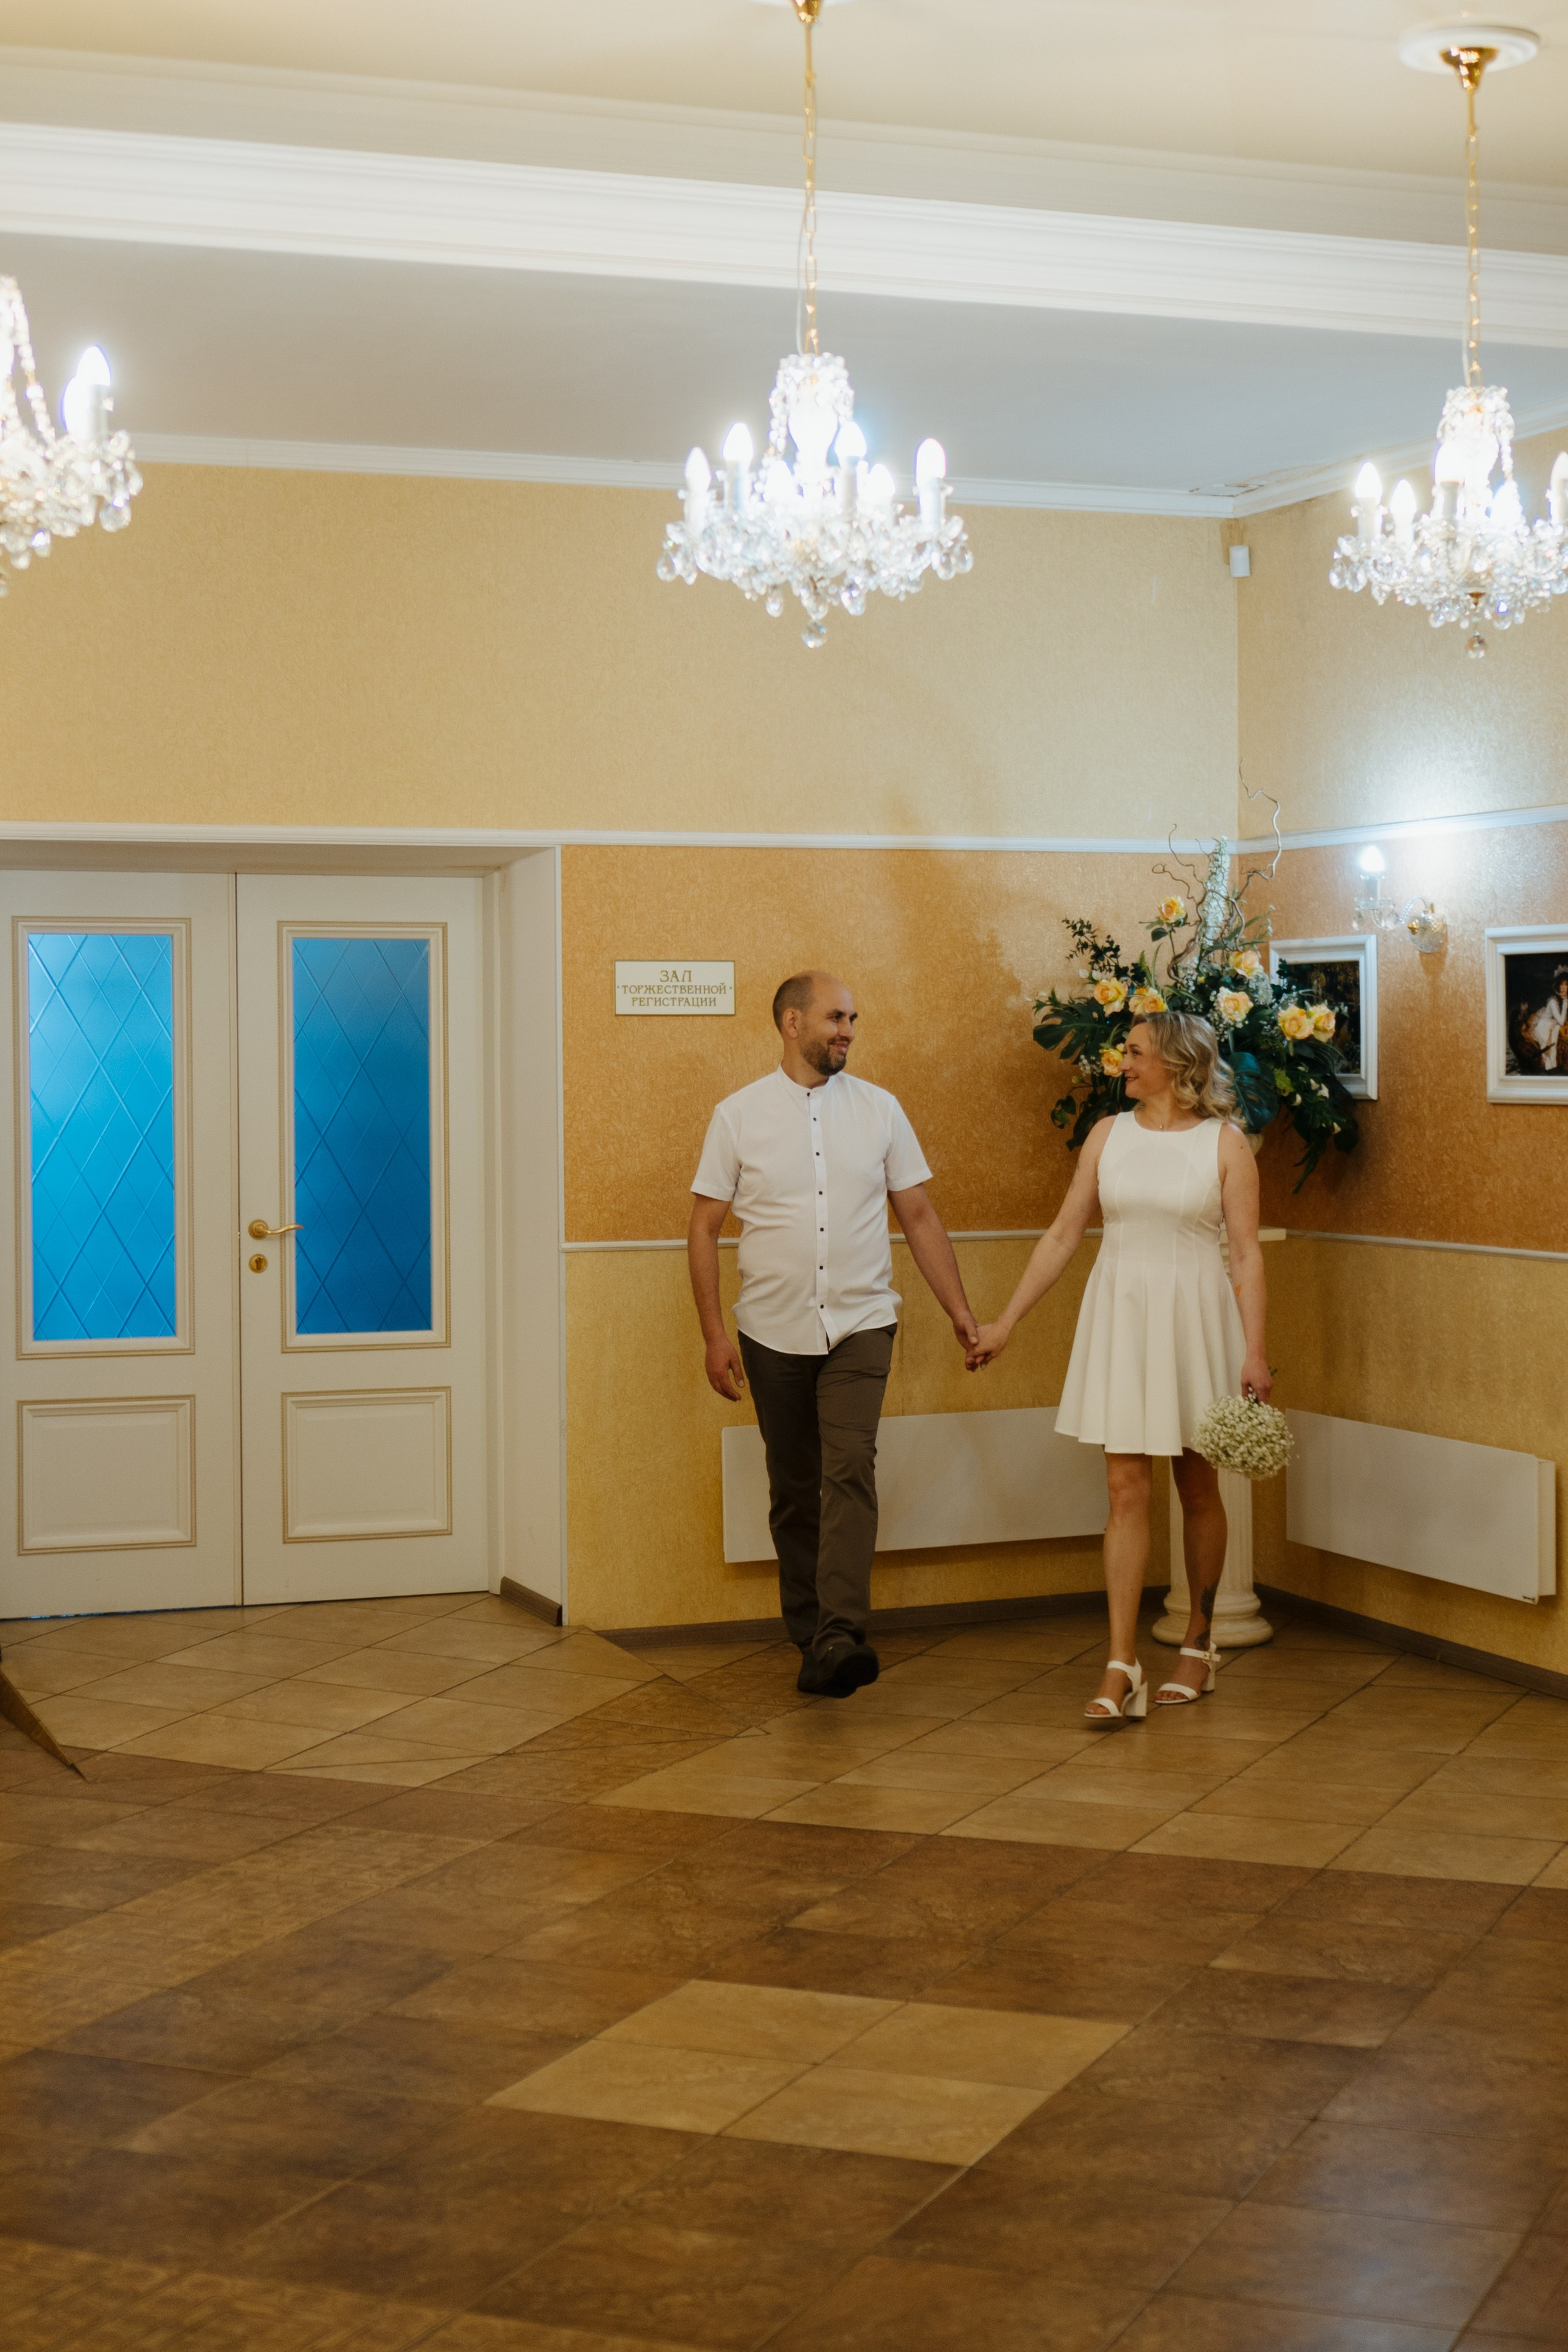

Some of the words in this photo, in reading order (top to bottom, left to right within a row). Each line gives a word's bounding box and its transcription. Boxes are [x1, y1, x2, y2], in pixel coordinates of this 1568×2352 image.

[660, 970, 692, 982] ЗАЛ
[622, 982, 726, 994] ТОРЖЕСТВЕННОЙ
[631, 997, 717, 1008] РЕГИСТРАЦИИ
